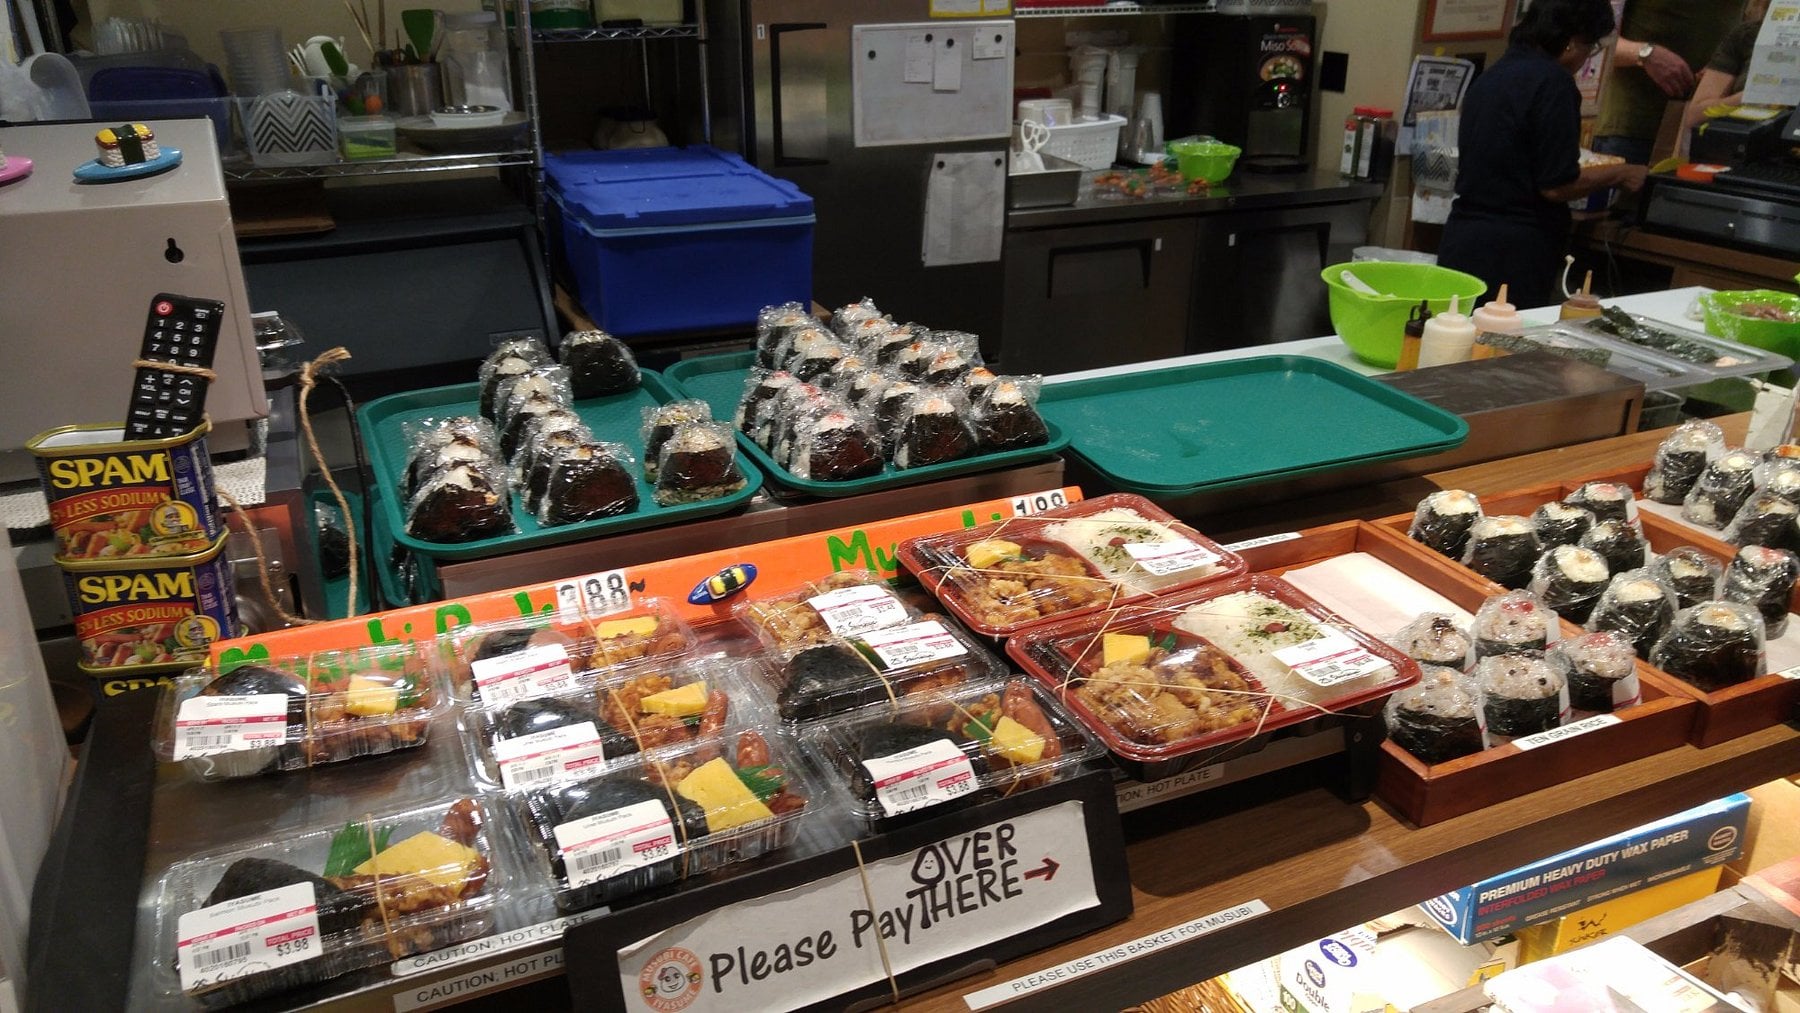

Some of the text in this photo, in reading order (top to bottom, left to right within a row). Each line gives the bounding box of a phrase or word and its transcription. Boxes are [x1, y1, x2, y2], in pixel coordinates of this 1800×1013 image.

[1260, 40, 1285, 51] Miso
[173, 334, 181, 342] 5
[192, 337, 200, 345] 6
[194, 324, 202, 332] 3
[170, 346, 179, 354] 8
[189, 349, 198, 357] 9
[50, 453, 170, 489] SPAM
[67, 497, 98, 518] LESS
[102, 492, 161, 508] SODIUM
[78, 571, 196, 604] SPAM
[94, 611, 123, 629] LESS
[127, 606, 184, 621] SODIUM
[1526, 718, 1607, 745] TEN GRAIN RICE
[946, 781, 970, 795] $3.88
[1147, 781, 1172, 795] HOT
[1174, 769, 1211, 787] PLATE
[642, 845, 668, 861] $3.88
[911, 823, 1017, 885] OVER
[1479, 875, 1541, 903] PREMIUM
[1542, 862, 1584, 884] HEAVY
[1585, 850, 1620, 871] DUTY
[1621, 841, 1649, 860] WAX
[1650, 829, 1690, 851] PAPER
[906, 859, 1023, 930] THERE
[1478, 887, 1548, 917] INTERFOLDED
[1550, 880, 1573, 894] WAX
[1574, 869, 1606, 886] PAPER
[268, 928, 313, 946] TOTAL PRICE
[277, 939, 309, 957] $3.98
[501, 929, 534, 945] HOT
[709, 903, 914, 993] Please Pay
[1011, 906, 1254, 993] PLEASE USE THIS BASKET FOR MUSUBI
[504, 958, 538, 978] HOT
[1296, 971, 1331, 1013] Double
